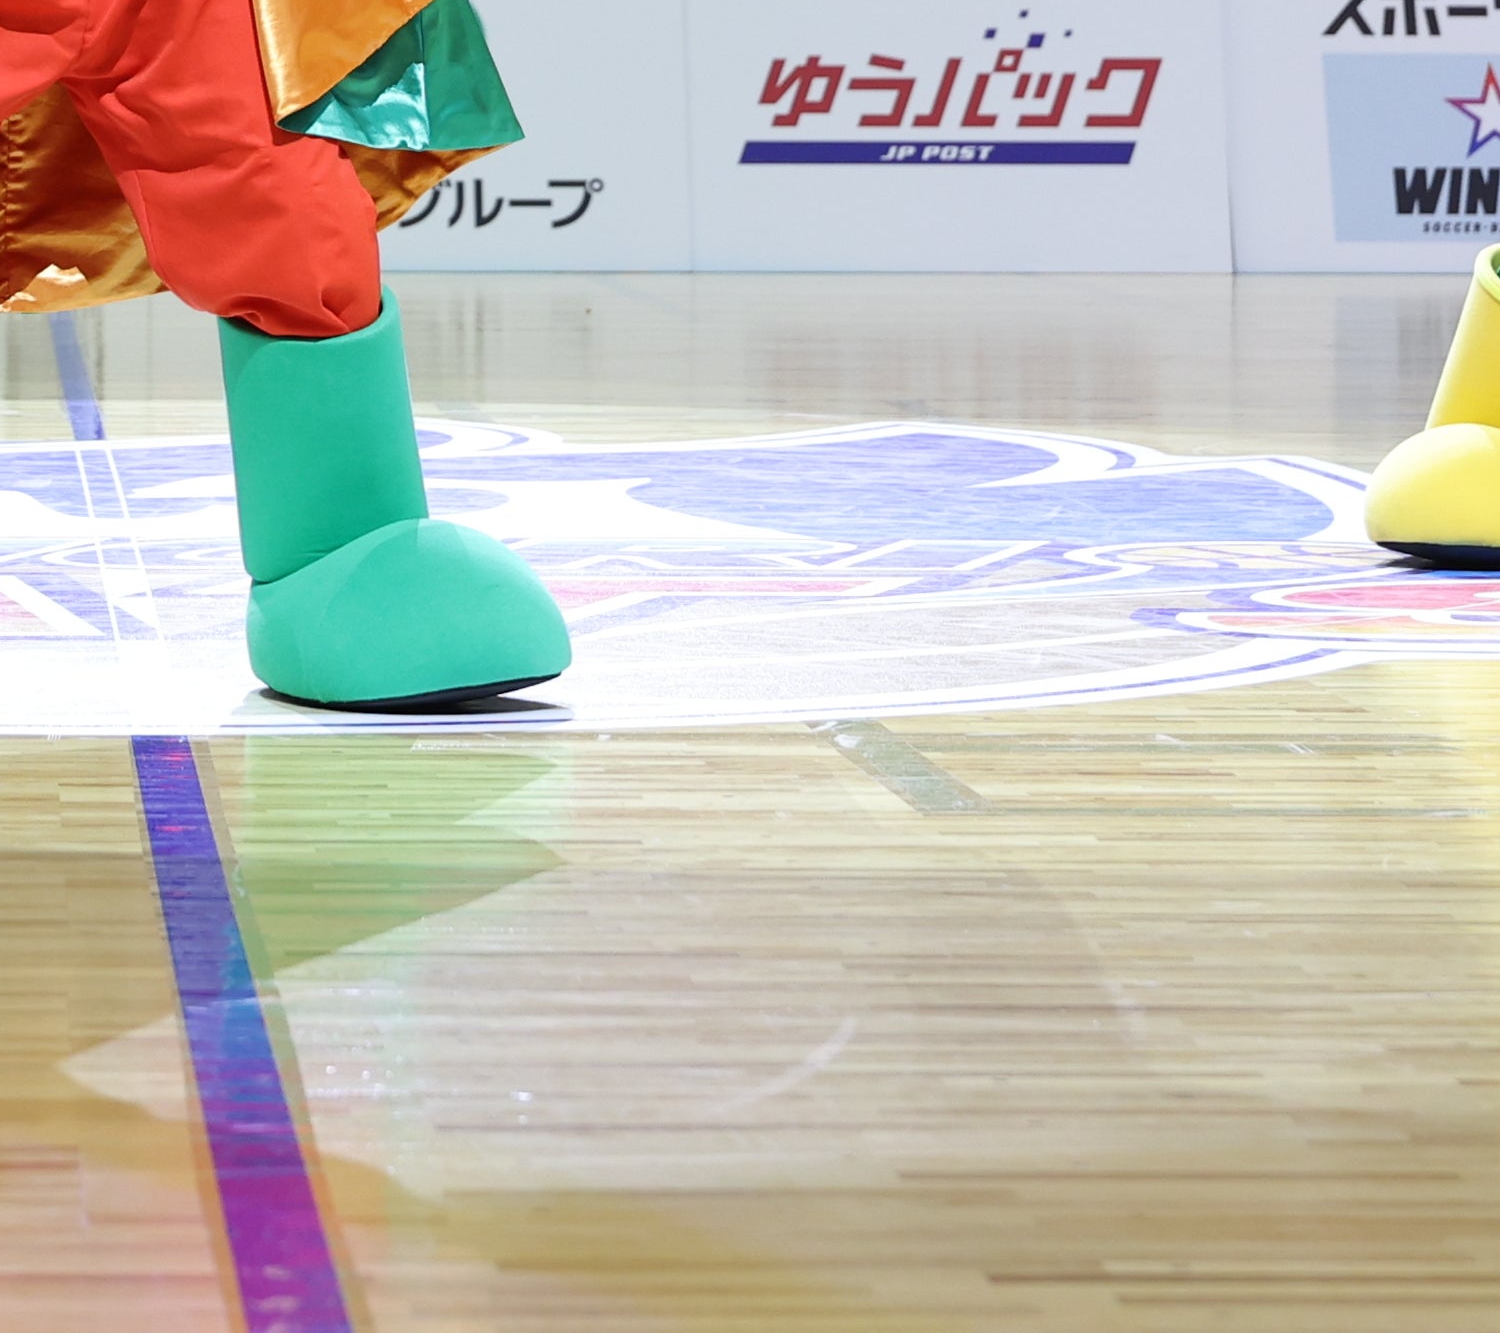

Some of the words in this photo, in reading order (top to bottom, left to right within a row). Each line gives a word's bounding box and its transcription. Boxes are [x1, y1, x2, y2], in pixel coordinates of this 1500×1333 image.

[757, 48, 1163, 128] ゆうパック
[879, 144, 917, 162] JP
[921, 144, 994, 162] POST
